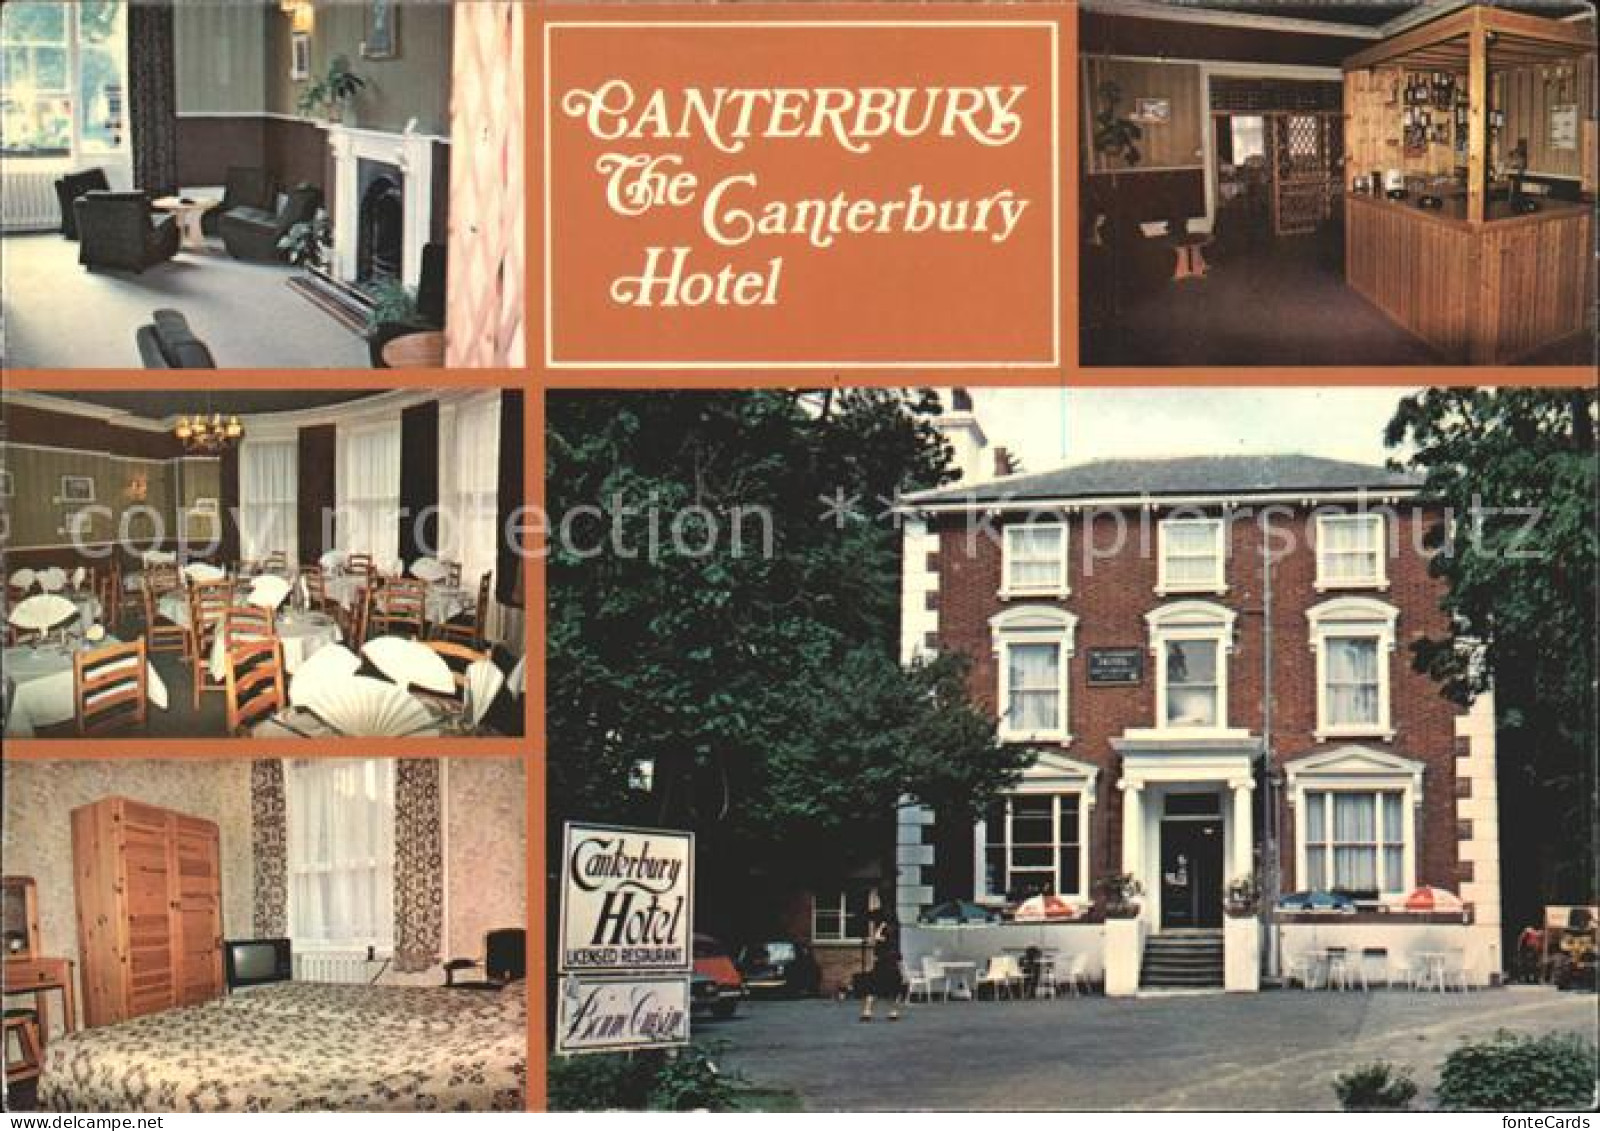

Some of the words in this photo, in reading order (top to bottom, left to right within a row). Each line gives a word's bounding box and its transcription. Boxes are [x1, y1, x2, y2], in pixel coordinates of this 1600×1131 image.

[562, 79, 1026, 154] CANTERBURY
[595, 153, 697, 216] The
[703, 173, 1029, 247] Canterbury
[610, 246, 783, 307] Hotel
[571, 838, 682, 894] Canterbury
[591, 891, 684, 945] Hotel
